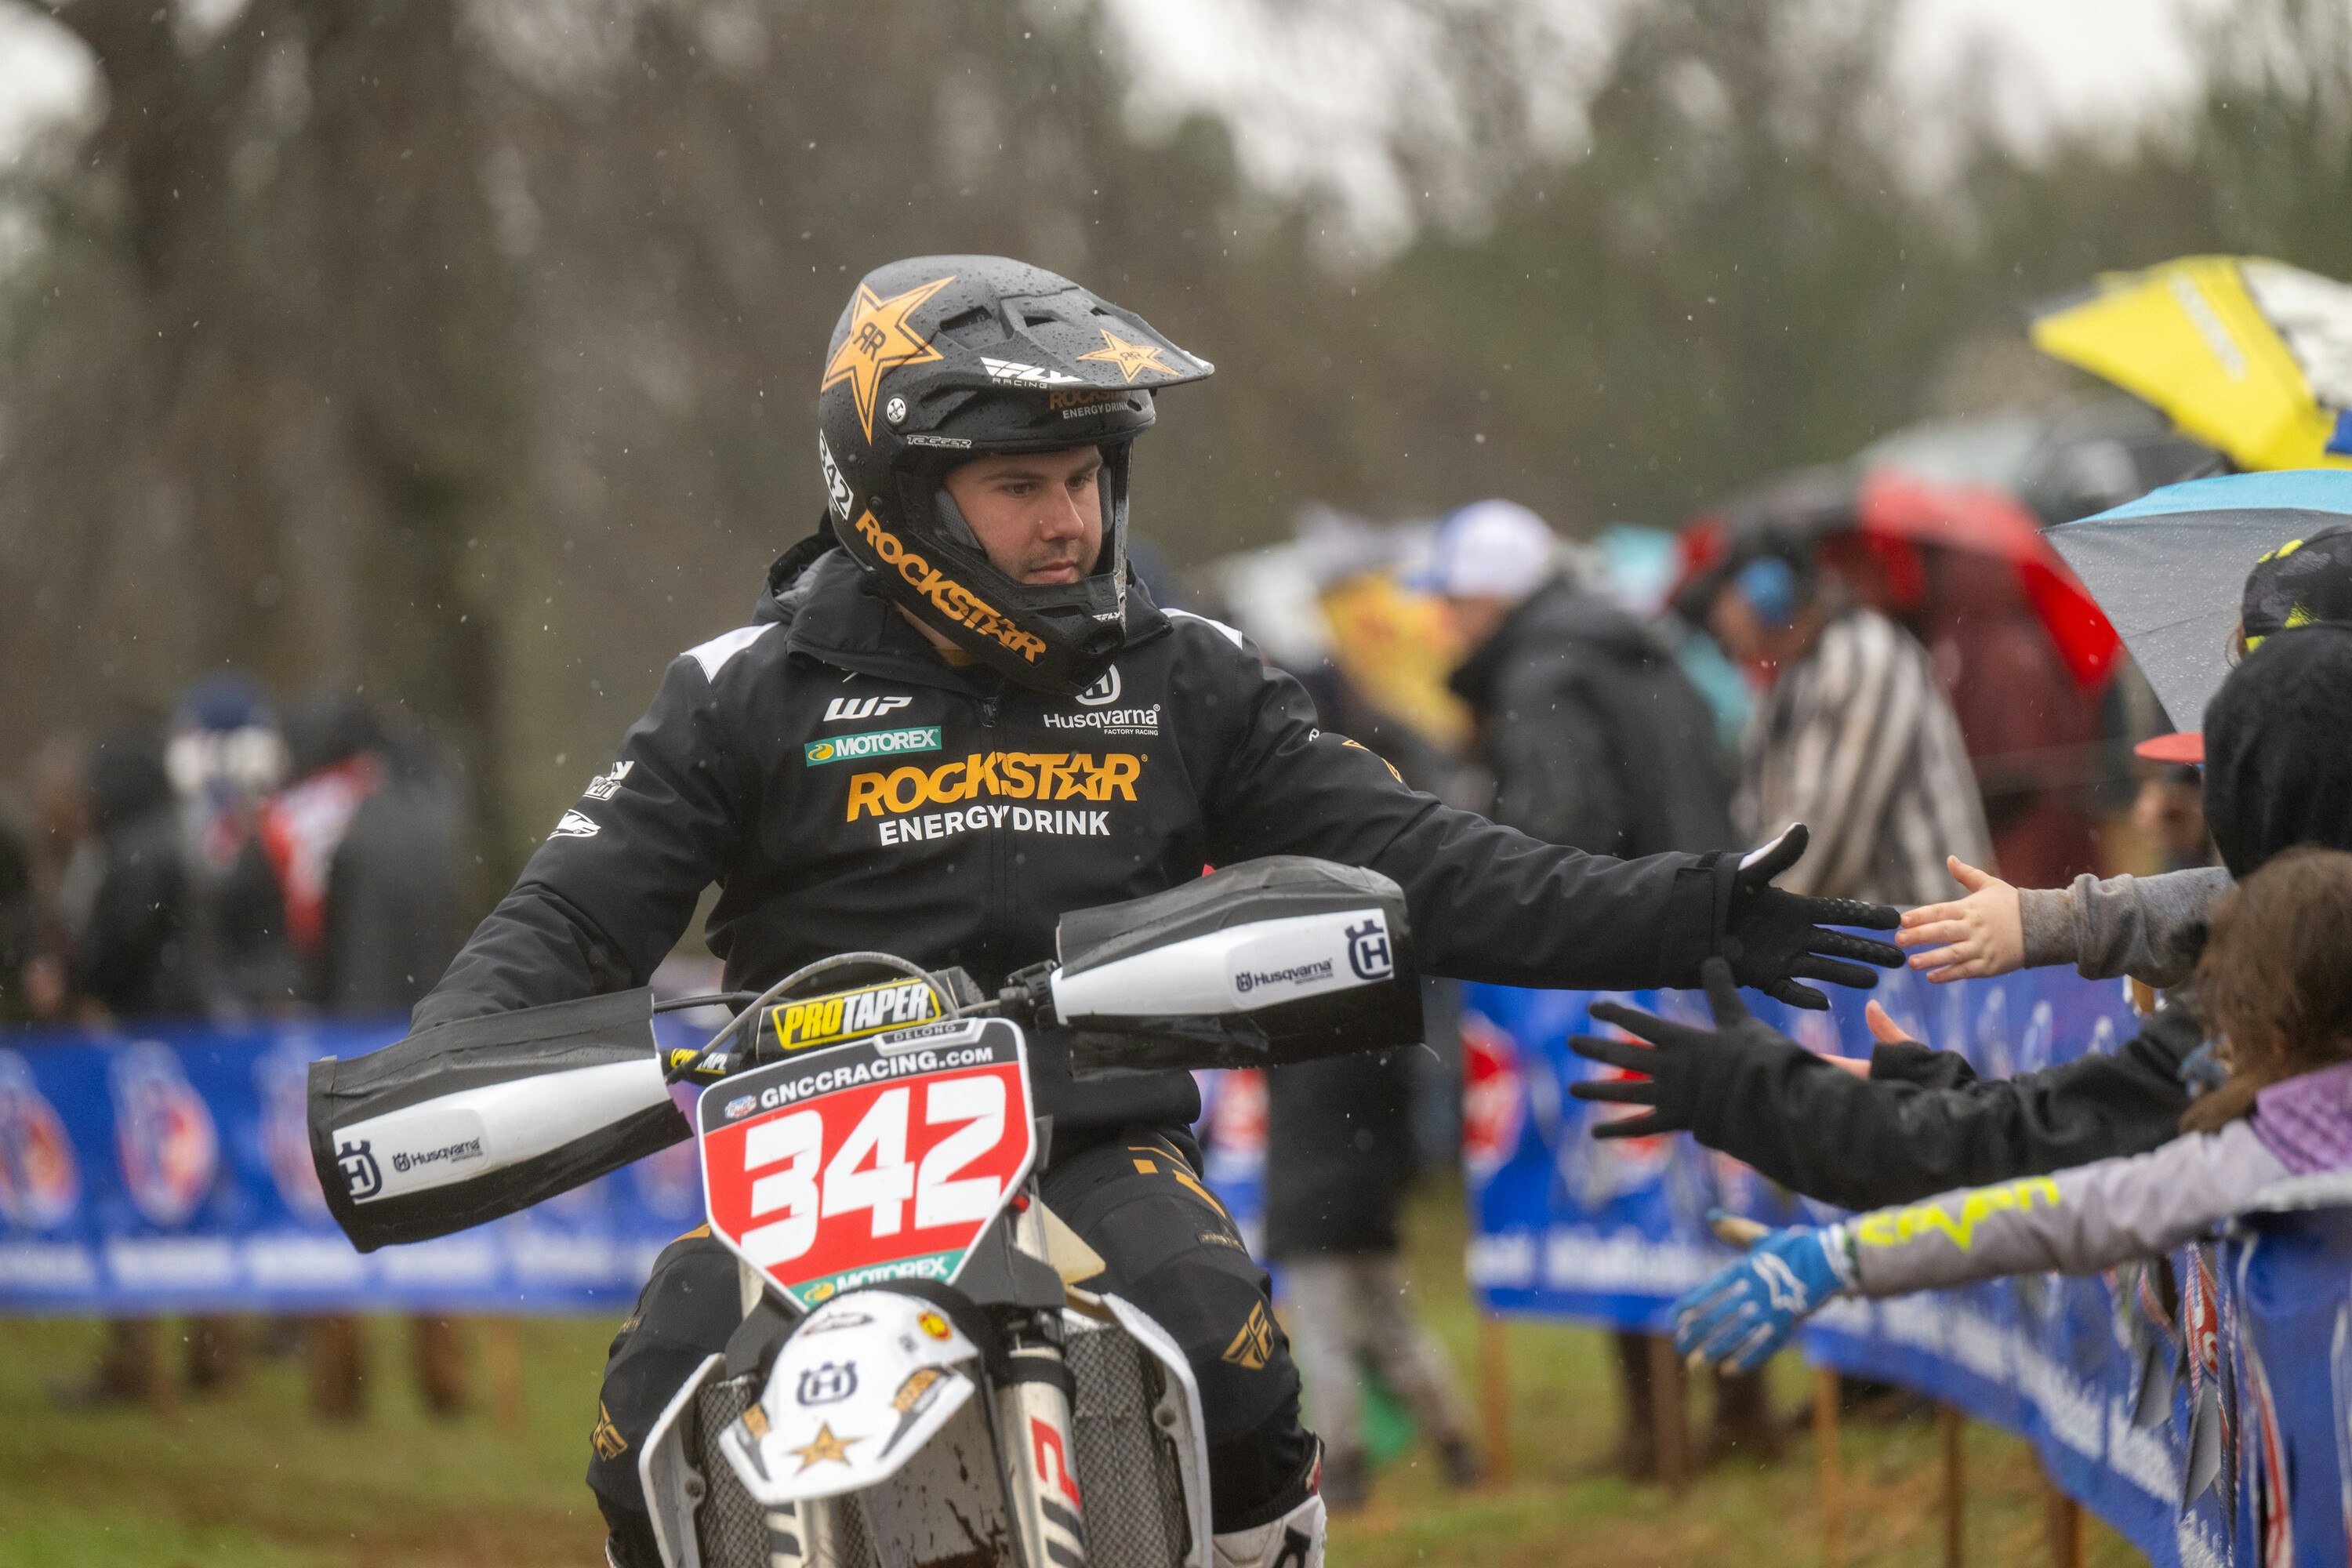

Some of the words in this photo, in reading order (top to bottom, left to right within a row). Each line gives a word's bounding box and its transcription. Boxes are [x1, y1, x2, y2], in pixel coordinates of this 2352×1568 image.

[992, 377, 1047, 389] RACING
[1062, 404, 1103, 419] ENERGY
[1105, 401, 1130, 412] DRINK
[855, 508, 1047, 663] ROCKSTAR
[823, 696, 913, 721] WP
[1044, 708, 1158, 729] Husqvarna
[836, 728, 937, 757] MOTOREX
[847, 751, 1141, 822] ROCKSTAR
[878, 804, 1010, 847] ENERGY
[1013, 807, 1110, 837] DRINK
[1254, 961, 1332, 985] Husqvarna
[782, 982, 931, 1047] PROTAPER
[894, 1024, 956, 1041] DELONG
[412, 1139, 480, 1166] Husqvarna
[740, 1075, 1007, 1269] 342
[837, 1256, 948, 1292] MOTOREX
